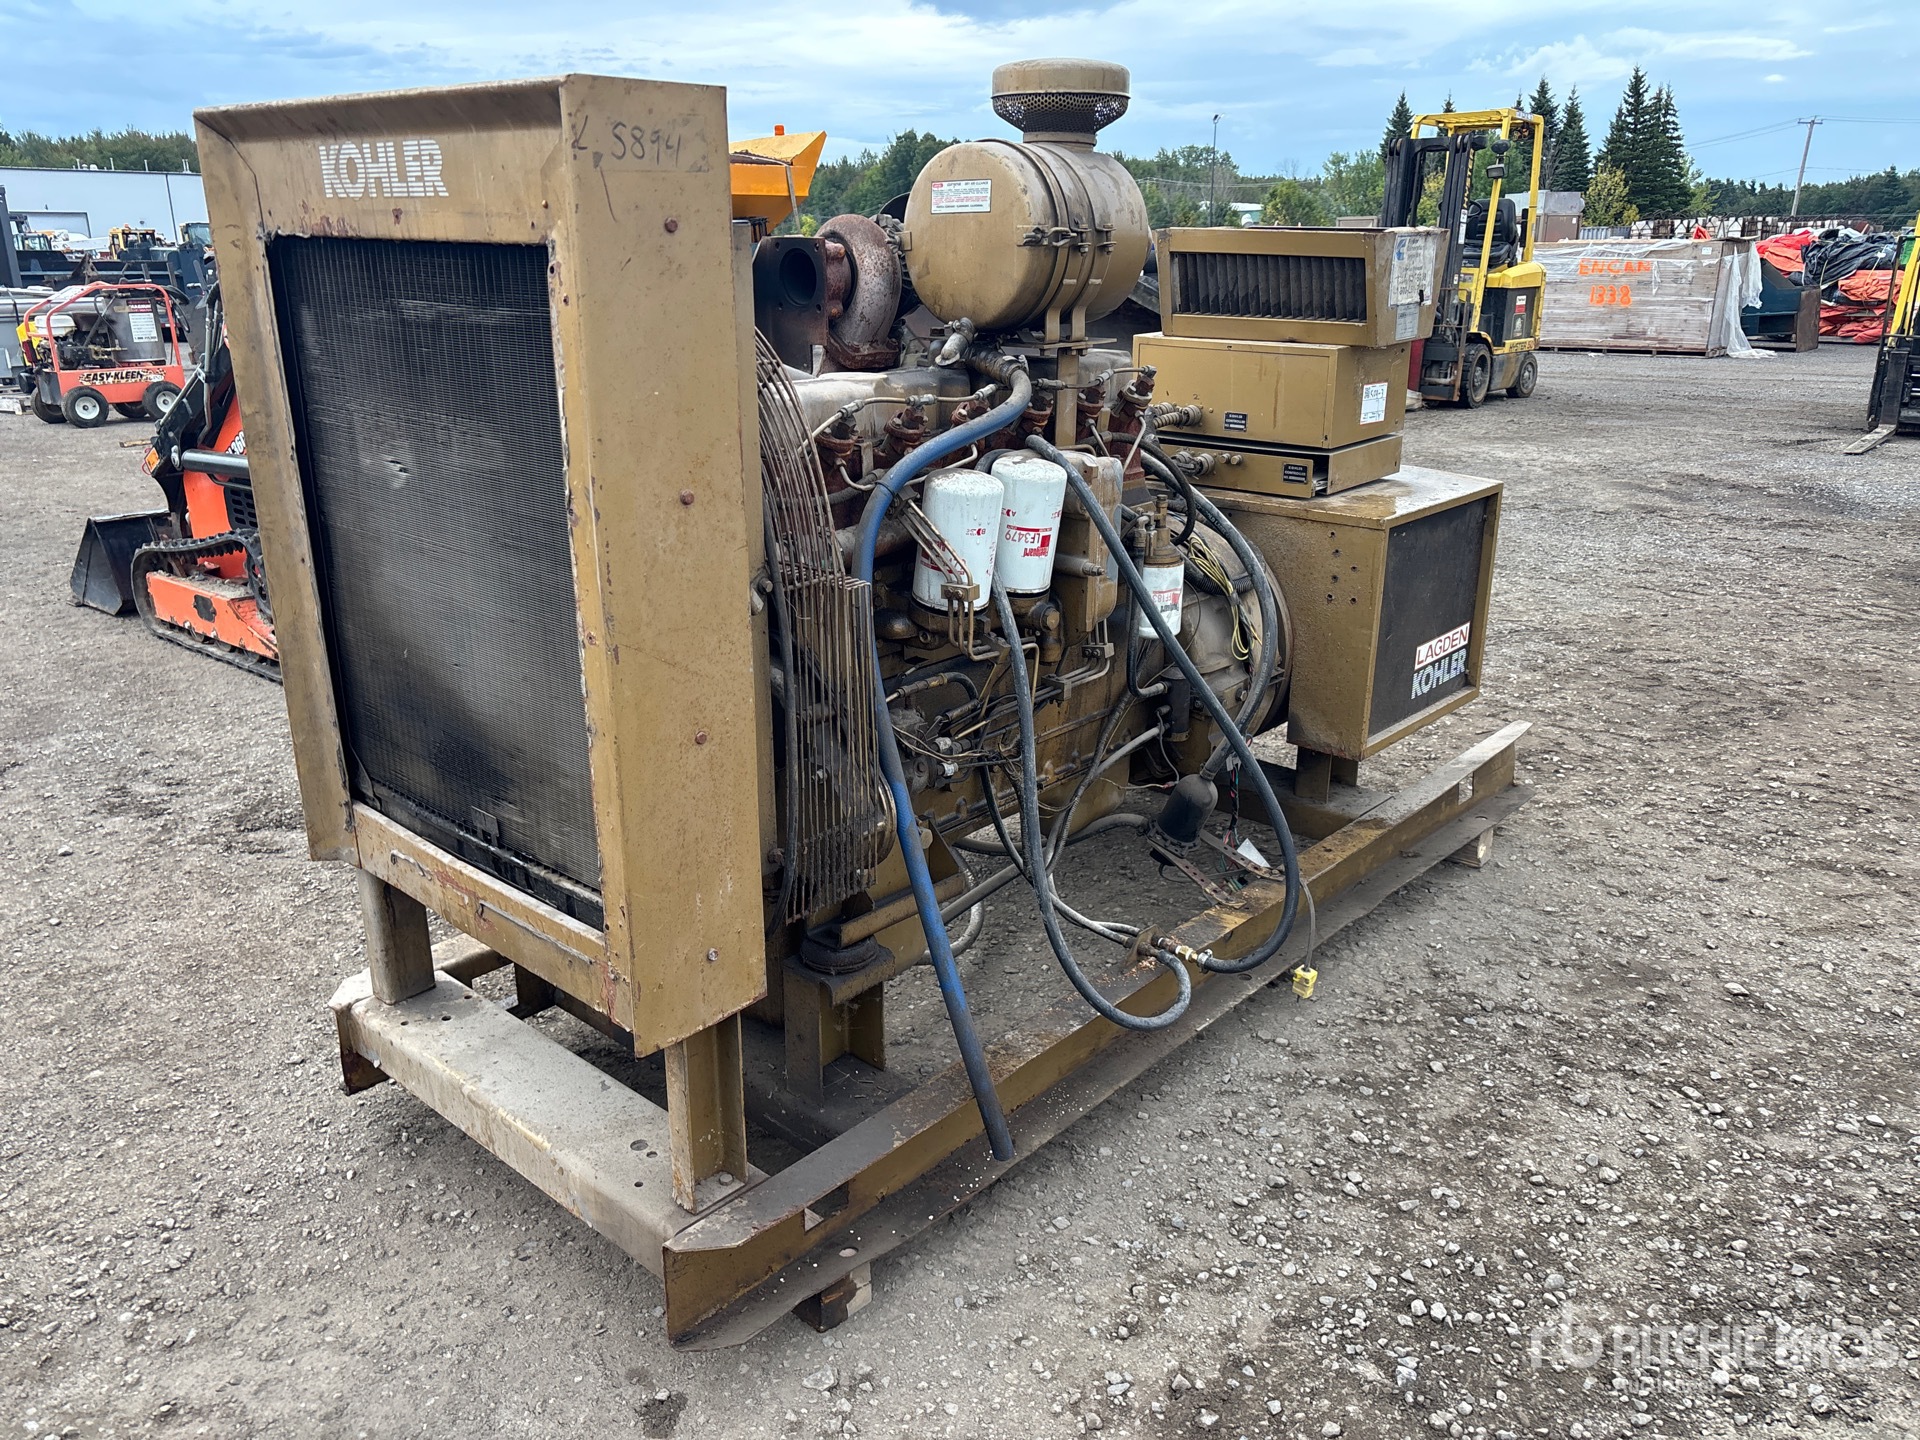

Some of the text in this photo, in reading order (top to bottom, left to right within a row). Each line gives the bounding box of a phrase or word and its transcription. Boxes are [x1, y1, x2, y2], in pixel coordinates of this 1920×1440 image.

[319, 140, 449, 200] KOHLER
[1463, 148, 1475, 208] HYSTER
[1578, 259, 1652, 275] ENCAN
[1590, 285, 1632, 306] 1338
[85, 370, 144, 382] EASY-KLEEN
[1005, 530, 1040, 544] LF3479
[1416, 626, 1468, 666] LAGDEN
[1411, 648, 1467, 699] KOHLER
